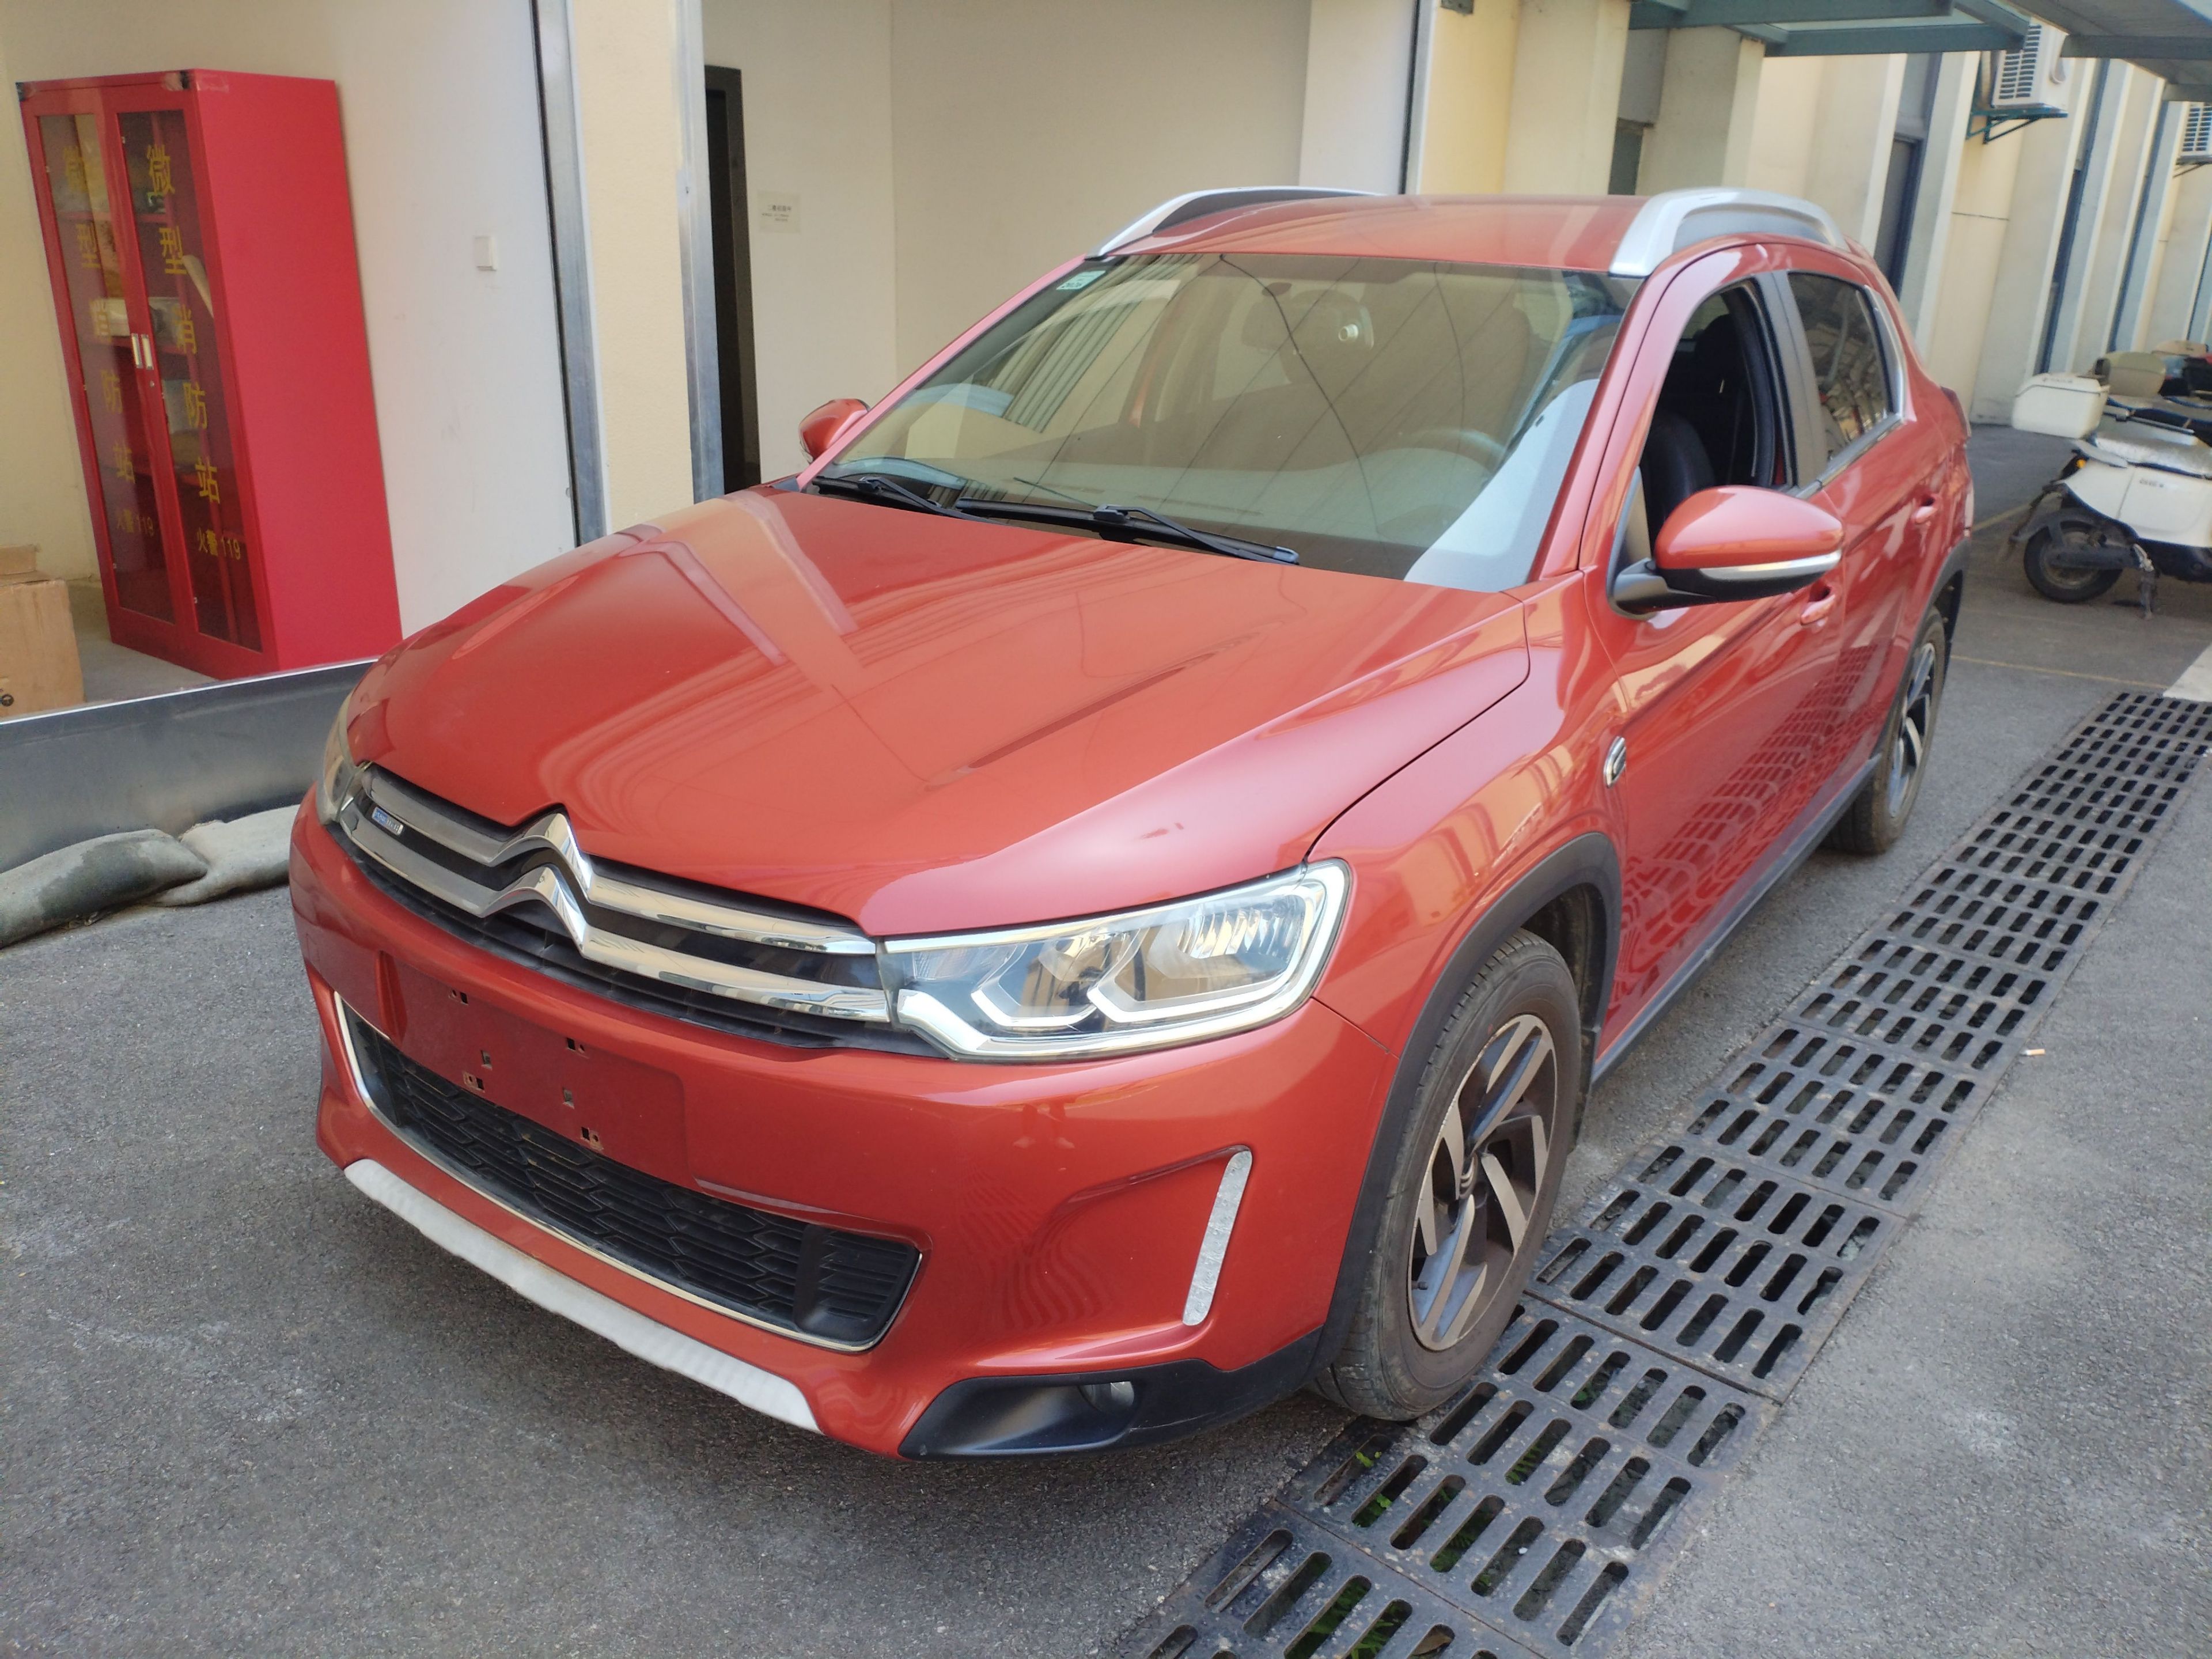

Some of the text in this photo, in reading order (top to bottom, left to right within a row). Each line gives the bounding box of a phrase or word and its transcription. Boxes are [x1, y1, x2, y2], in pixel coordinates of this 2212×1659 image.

[147, 144, 220, 504] 微型消防站
